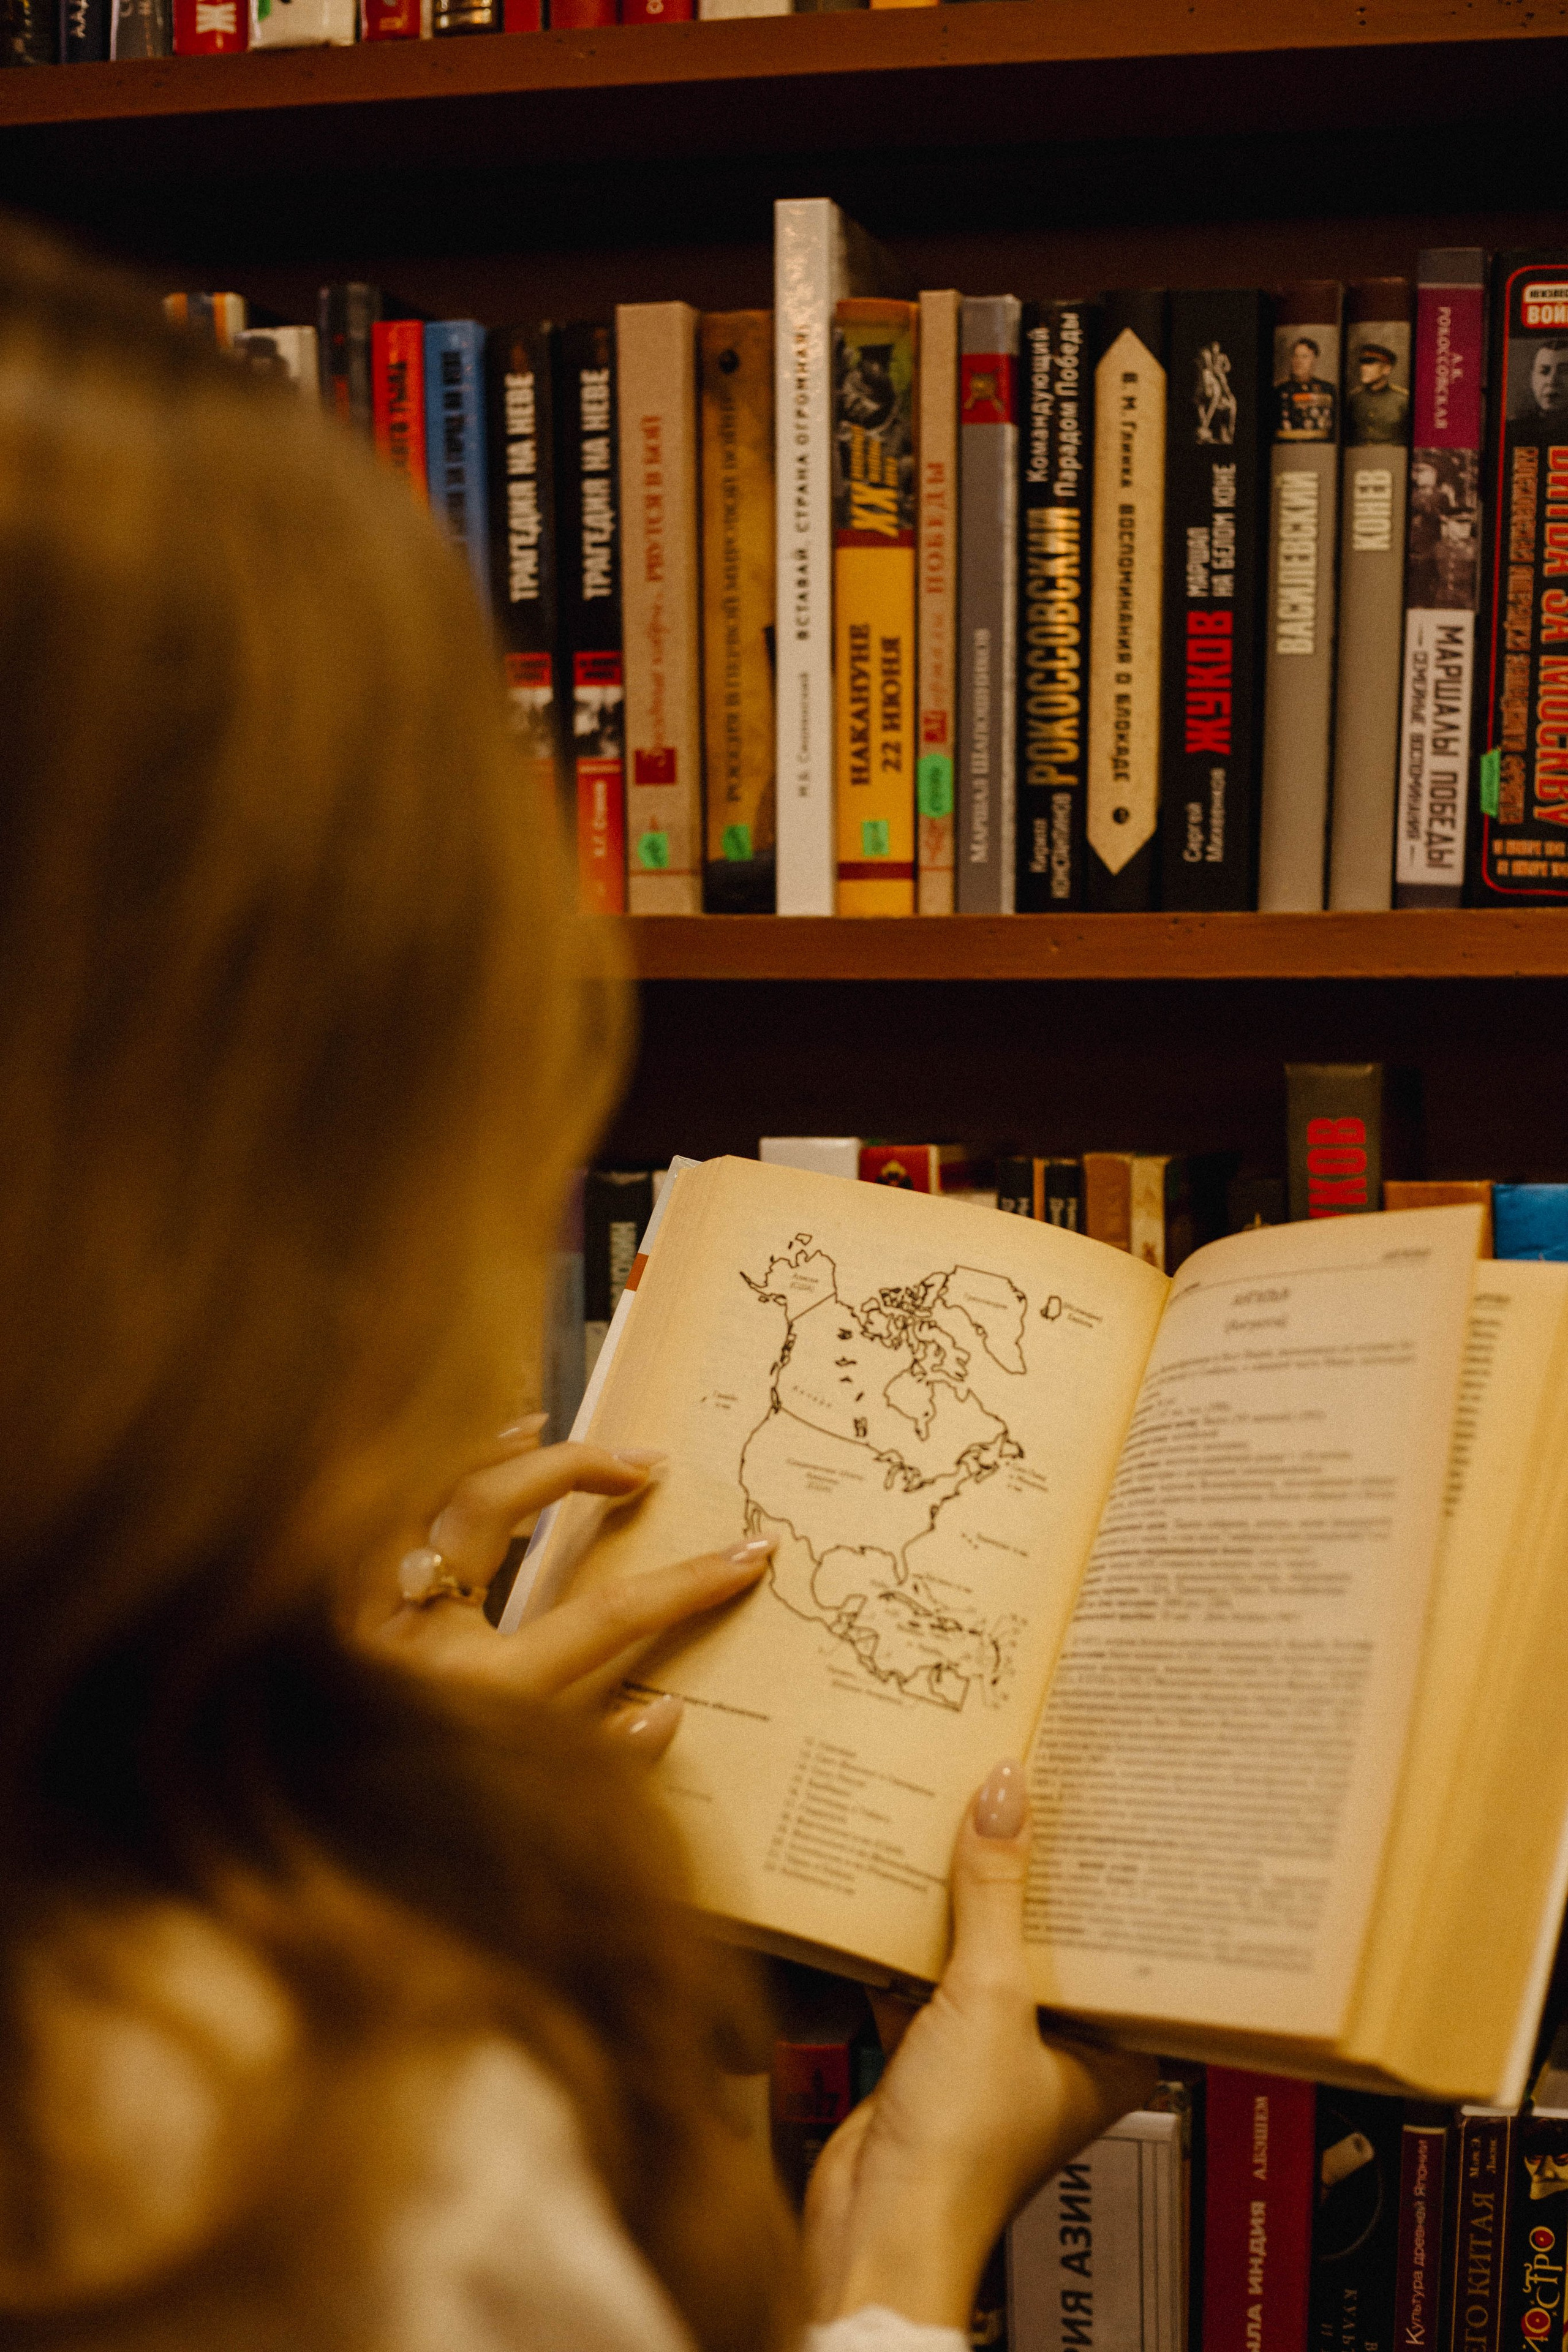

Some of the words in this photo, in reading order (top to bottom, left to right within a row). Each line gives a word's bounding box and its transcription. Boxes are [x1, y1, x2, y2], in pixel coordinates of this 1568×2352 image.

[1053, 312, 1084, 397] Победы
[1434, 306, 1452, 429] РОКОССОВСКАЯ
[504, 371, 537, 435] НЕВЕ
[579, 369, 611, 431] НЕВЕ
[1025, 328, 1055, 483] Командующий
[507, 439, 538, 475] НА
[580, 436, 611, 471] НА
[1053, 402, 1084, 497] Парадом
[1121, 422, 1137, 488] Глинка
[1212, 462, 1237, 507] КОНЕ
[795, 453, 810, 533] СТРАНА
[1352, 470, 1392, 551] КОНЕВ
[508, 482, 541, 603] ТРАГЕДИЯ
[582, 478, 616, 601] ТРАГЕДИЯ
[1186, 527, 1211, 598] МАРШАЛ
[1212, 513, 1236, 570] БЕЛОМ
[1275, 471, 1318, 655] ВАСИЛЕВСКИЙ
[1115, 503, 1136, 663] ВОСПОМИНАНИЯ
[1212, 574, 1234, 598] НА
[850, 624, 870, 786] НАКАНУНЕ
[880, 636, 901, 733] ИЮНЯ
[1115, 673, 1133, 685] О
[1185, 611, 1234, 755] ЖУКОВ
[1432, 625, 1465, 757] МАРШАЛЫ
[880, 742, 902, 773] 22
[1110, 693, 1131, 782] БЛОКАДЕ
[1424, 770, 1458, 870] ПОБЕДЫ
[1414, 2142, 1428, 2200] Японии
[1060, 2163, 1093, 2278] АЗИИ
[1247, 2201, 1267, 2294] ИНДИЯ
[1412, 2204, 1427, 2267] древней
[1468, 2194, 1496, 2297] КИТАЯ
[1060, 2291, 1093, 2352] ИЯ
[1405, 2270, 1426, 2345] Культура
